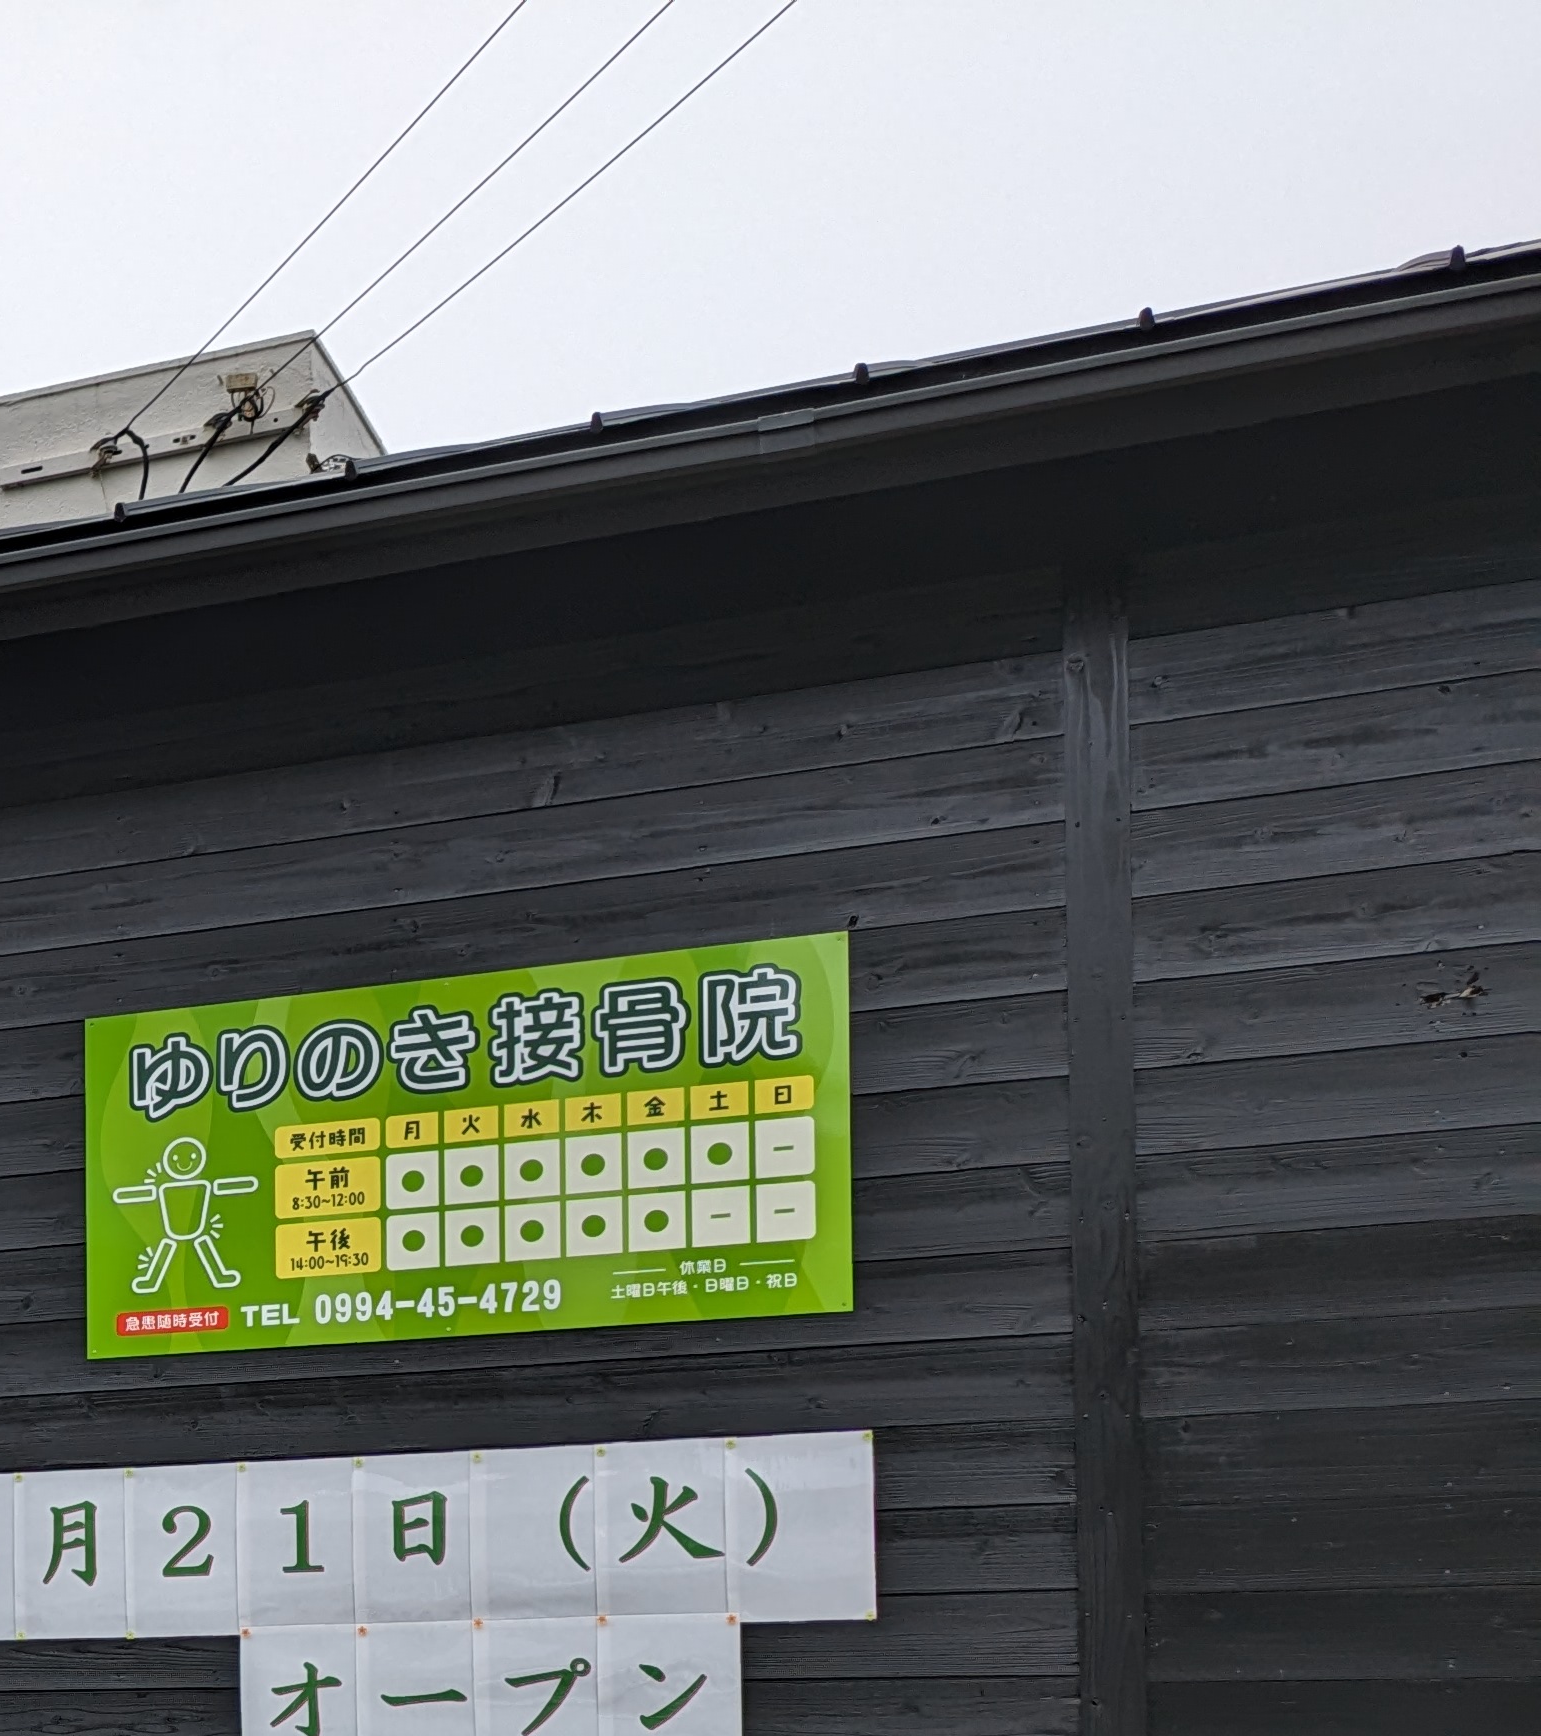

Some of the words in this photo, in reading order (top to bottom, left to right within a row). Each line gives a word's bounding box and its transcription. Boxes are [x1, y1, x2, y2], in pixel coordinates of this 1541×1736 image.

[130, 963, 803, 1121] ゆりのき接骨院
[289, 1126, 366, 1152] 受付時間
[404, 1121, 421, 1141] 月
[462, 1115, 480, 1135] 火
[521, 1109, 542, 1129] 水
[581, 1102, 602, 1123] 木
[644, 1096, 666, 1118] 金
[709, 1091, 729, 1111] 土
[775, 1085, 792, 1105] 日
[305, 1168, 349, 1190] 午前
[306, 1229, 351, 1252] 午後
[679, 1258, 727, 1276] 休業日
[241, 1304, 300, 1327] TEL
[314, 1278, 563, 1325] 0994-45-4729
[125, 1311, 220, 1331] 急患随時受付
